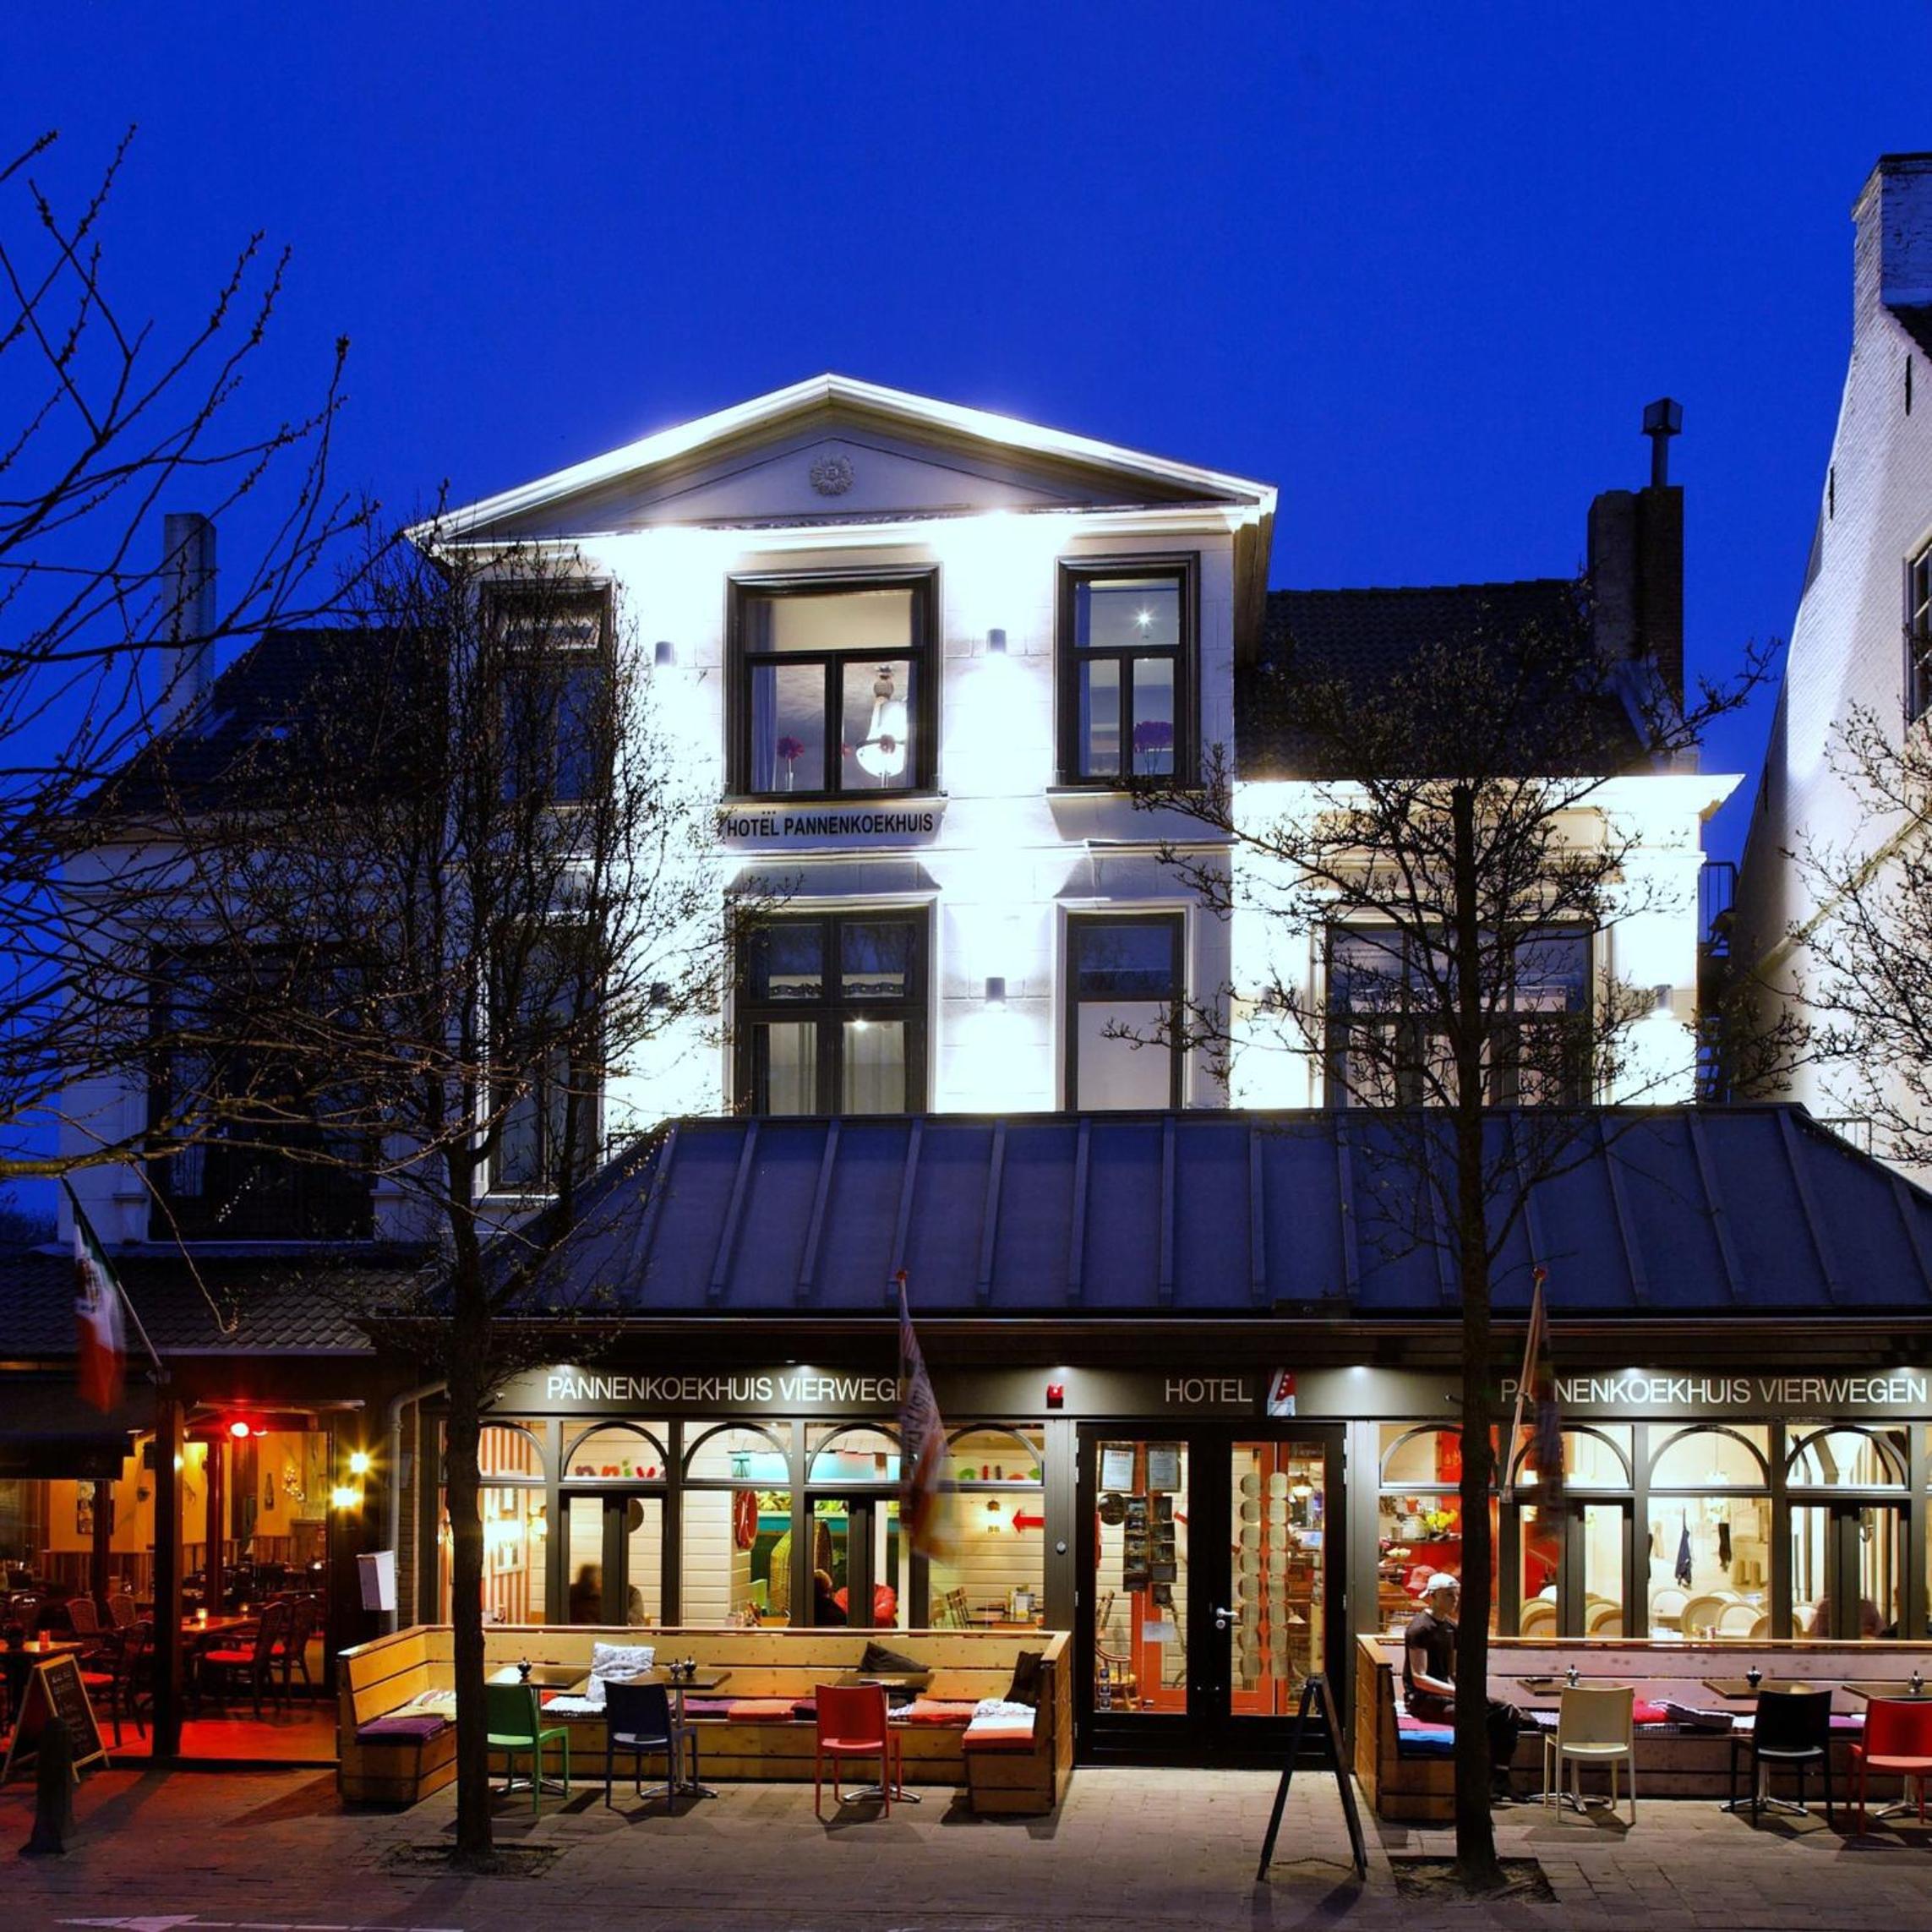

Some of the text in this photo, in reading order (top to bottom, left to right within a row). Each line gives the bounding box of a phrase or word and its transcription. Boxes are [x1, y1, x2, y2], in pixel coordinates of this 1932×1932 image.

[783, 813, 933, 835] PANNENKOEKHUIS
[547, 1376, 903, 1402] PANNENKOEKHUIS VIERWEG
[1165, 1378, 1253, 1403] HOTEL
[1500, 1378, 1928, 1404] PNENKOEKHUIS VIERWEGEN
